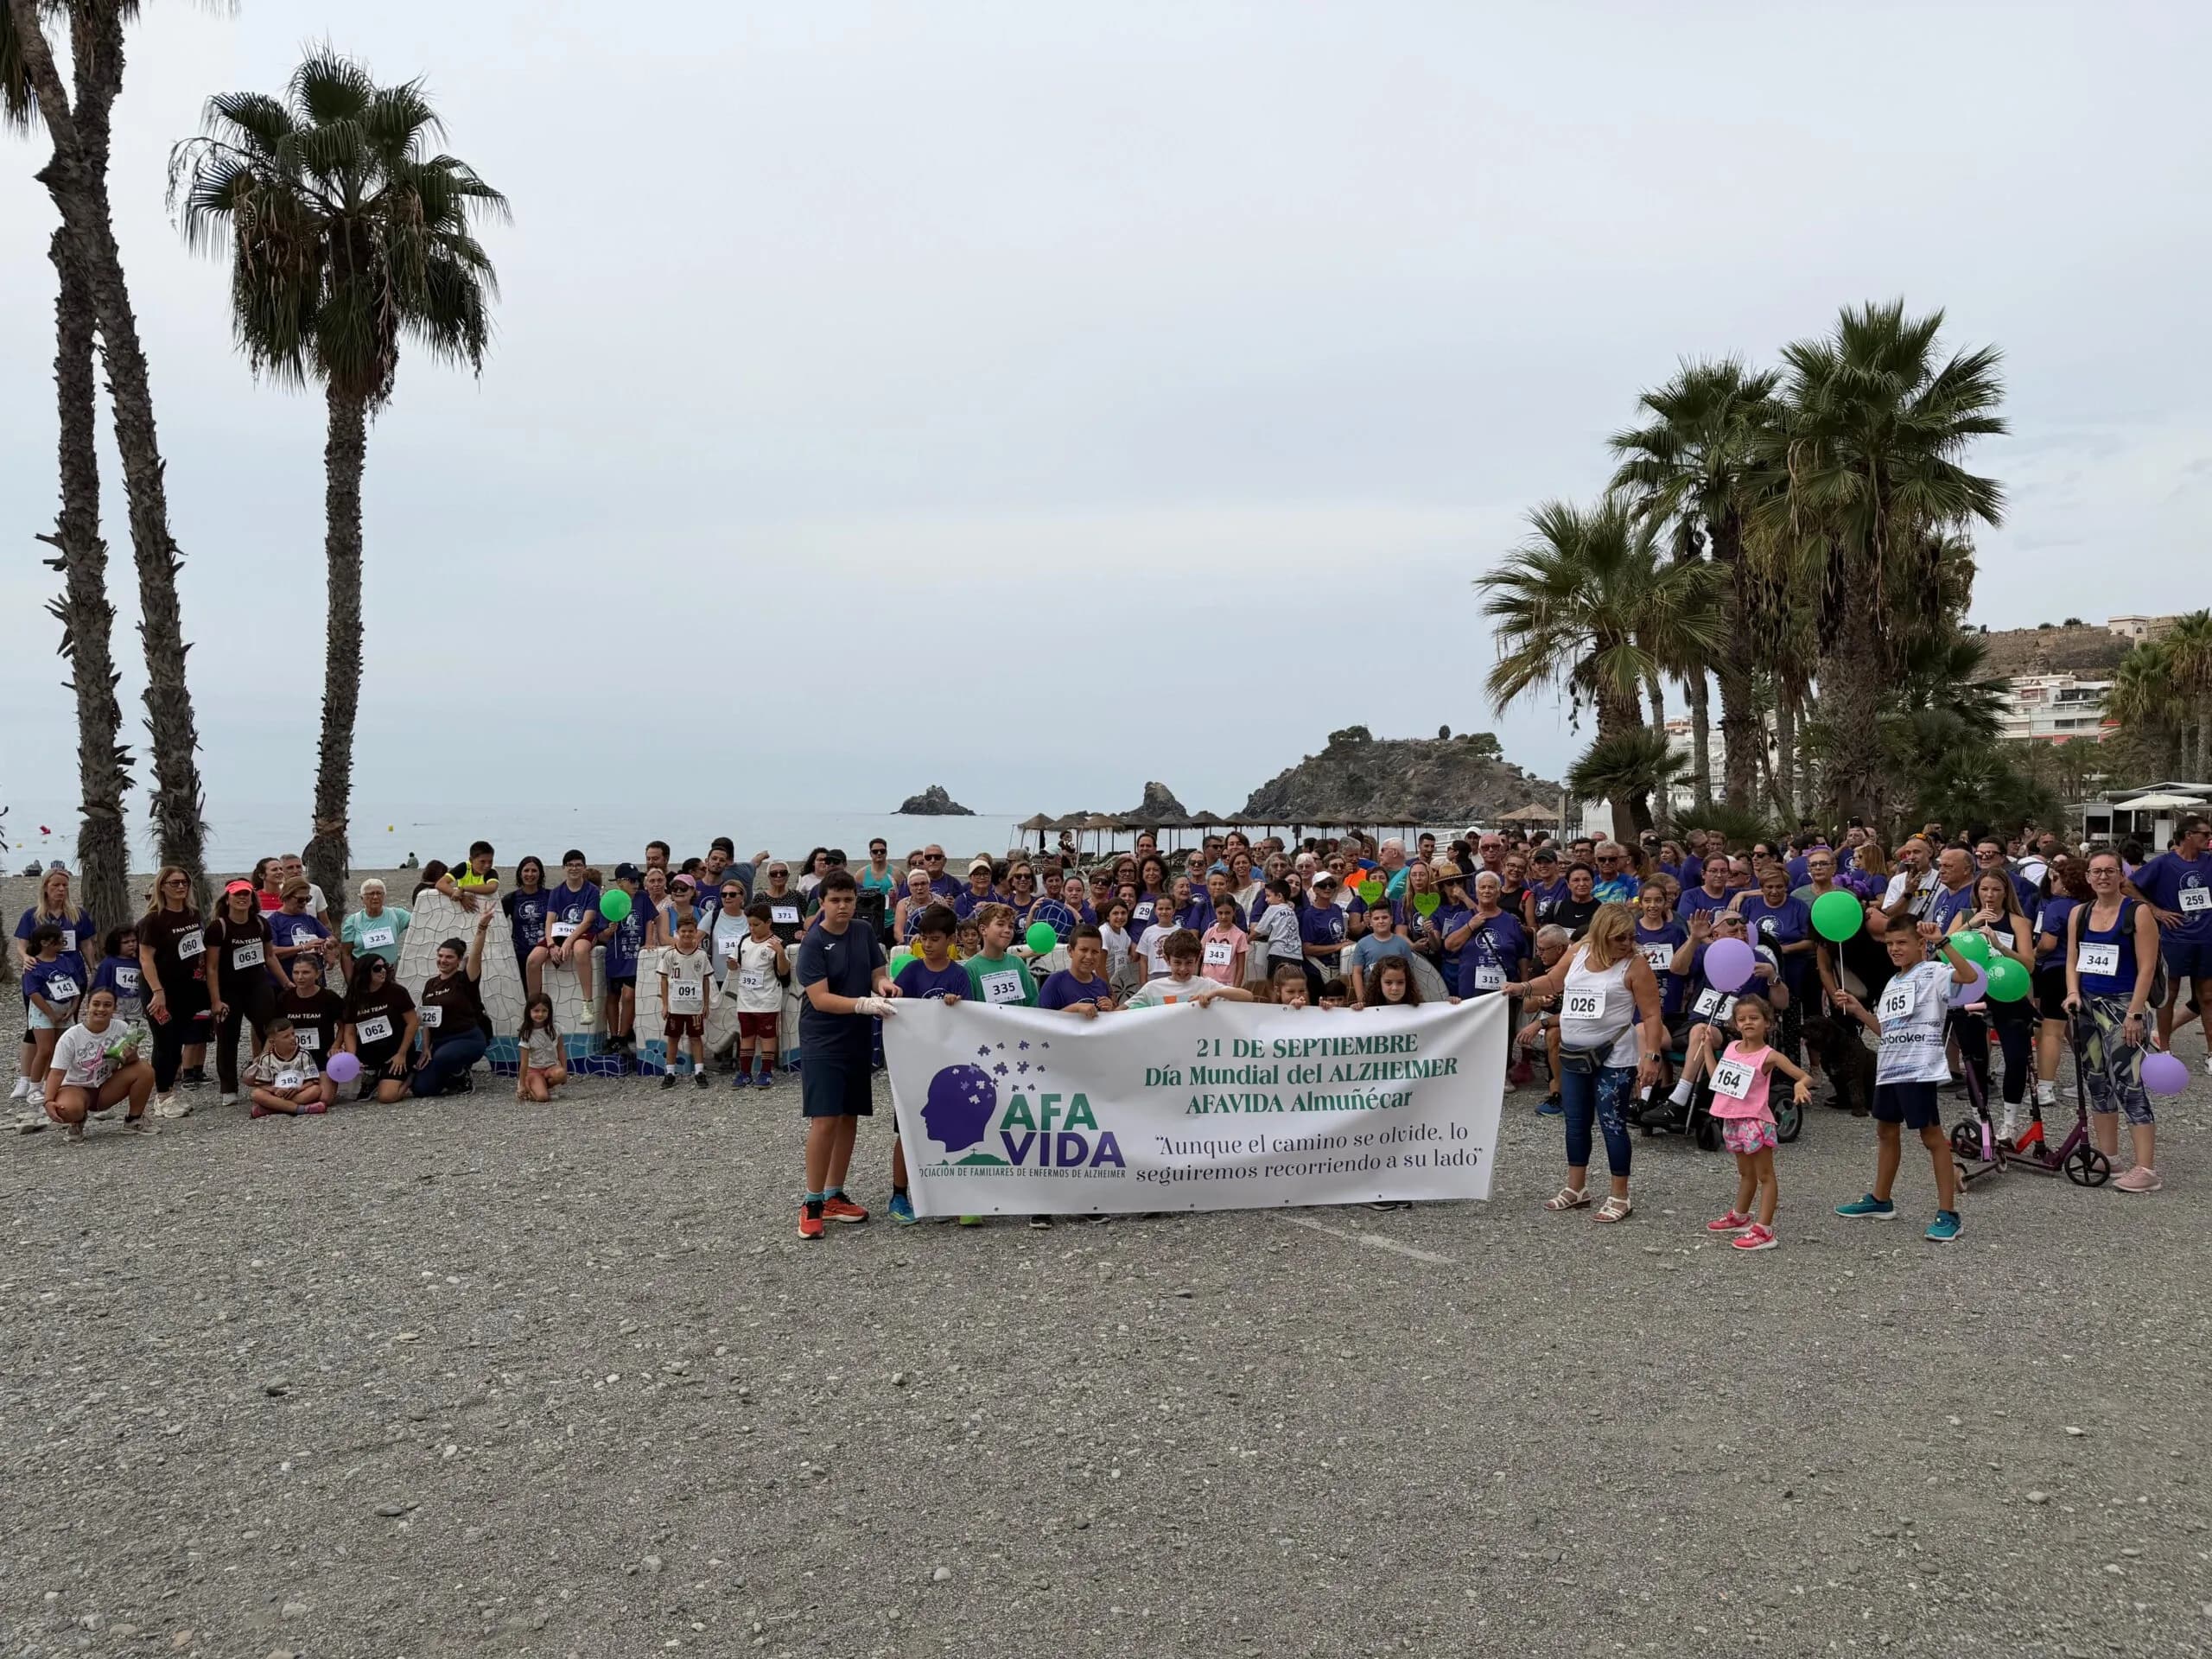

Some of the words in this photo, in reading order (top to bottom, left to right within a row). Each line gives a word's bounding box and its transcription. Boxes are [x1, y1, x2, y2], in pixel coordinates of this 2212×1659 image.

[2185, 894, 2204, 906] 259
[182, 939, 197, 952] 060
[238, 950, 257, 963] 063
[2087, 955, 2108, 966] 344
[1482, 976, 1500, 984] 315
[56, 982, 73, 994] 143
[678, 987, 696, 995] 091
[993, 982, 1015, 995] 335
[371, 1004, 388, 1013] TEAM
[1571, 998, 1596, 1012] 026
[1885, 995, 1906, 1013] 165
[423, 1013, 436, 1022] 226
[365, 1024, 385, 1037] 062
[1197, 1039, 1221, 1057] 21
[1233, 1039, 1265, 1058] DE
[1273, 1033, 1419, 1058] SEPTIEMBRE
[1145, 1065, 1181, 1086] Día
[1189, 1065, 1279, 1085] Mundial
[1287, 1063, 1322, 1085] del
[1328, 1058, 1458, 1082] ALZHEIMER
[281, 1077, 298, 1085] 382
[1718, 1069, 1741, 1090] 164
[1185, 1093, 1285, 1114] AFAVIDA
[1290, 1086, 1414, 1111] Almuñécar
[999, 1093, 1099, 1130] AFA
[1249, 1135, 1266, 1153] el
[1272, 1134, 1347, 1153] camino
[1353, 1133, 1374, 1147] se
[1451, 1122, 1468, 1140] lo
[999, 1131, 1127, 1167] VIDA
[957, 1167, 967, 1176] DE
[970, 1167, 1014, 1177] FAMILIARES
[1017, 1167, 1027, 1176] DE
[1029, 1168, 1070, 1177] ENFERMOS
[1071, 1169, 1082, 1178] DE
[1084, 1169, 1126, 1178] ALZHEIMER
[1136, 1165, 1258, 1186] seguiremos
[1264, 1154, 1381, 1178] recorriendo
[1386, 1155, 1397, 1168] a
[1403, 1154, 1426, 1167] su
